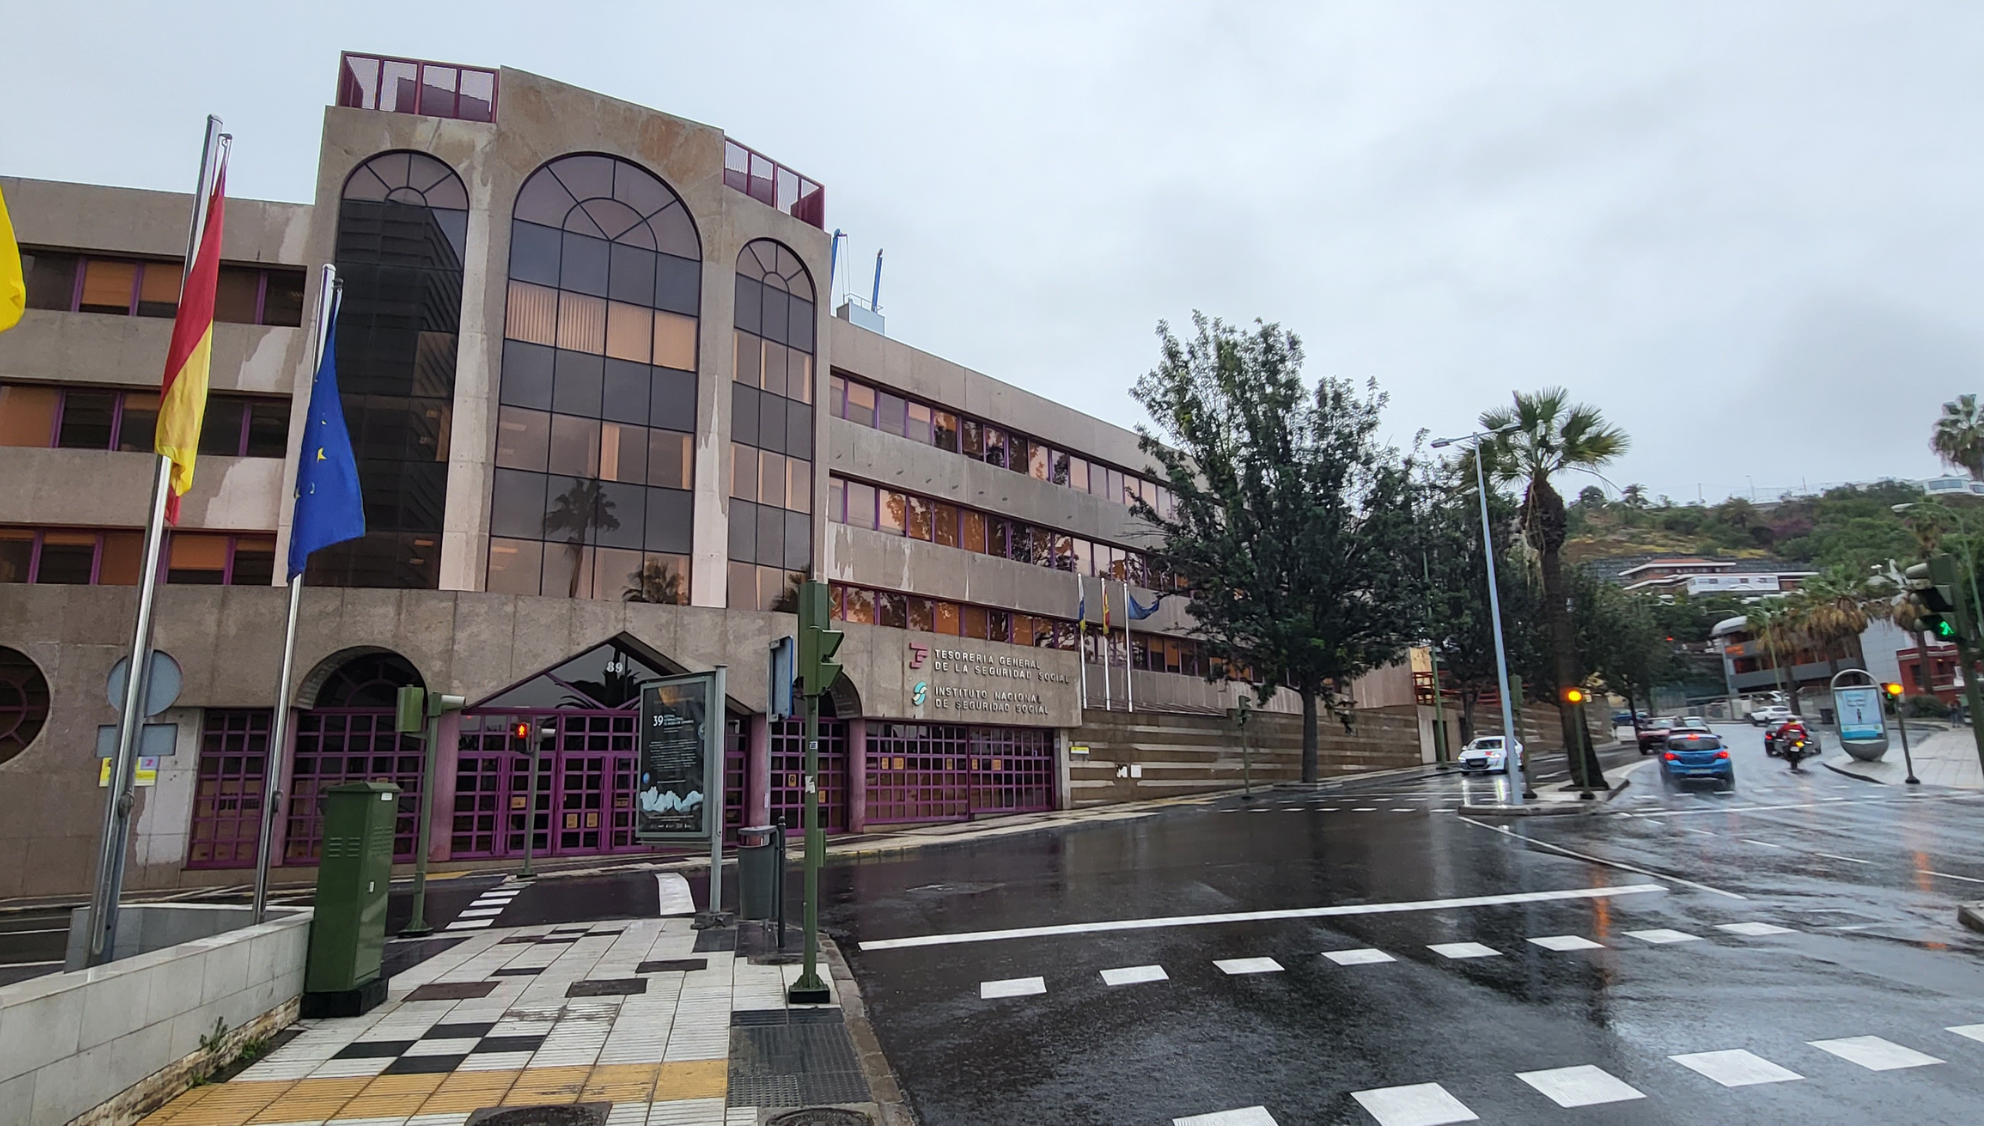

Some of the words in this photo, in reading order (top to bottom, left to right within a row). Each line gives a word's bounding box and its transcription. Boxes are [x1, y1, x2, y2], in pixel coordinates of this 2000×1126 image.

[606, 661, 623, 673] 89
[934, 649, 994, 664] TESORERIA
[999, 656, 1041, 670] GENERAL
[934, 662, 948, 672] DE
[954, 664, 968, 673] LA
[974, 665, 1032, 679] SEGURIDAD
[1038, 672, 1069, 684] SOCIAL
[934, 687, 988, 699] INSTITUTO
[994, 691, 1042, 704] NACIONAL
[934, 699, 948, 708] DE
[955, 700, 1010, 713] SEGURIDAD
[1015, 704, 1049, 716] SOCIAL
[653, 715, 664, 726] 39
